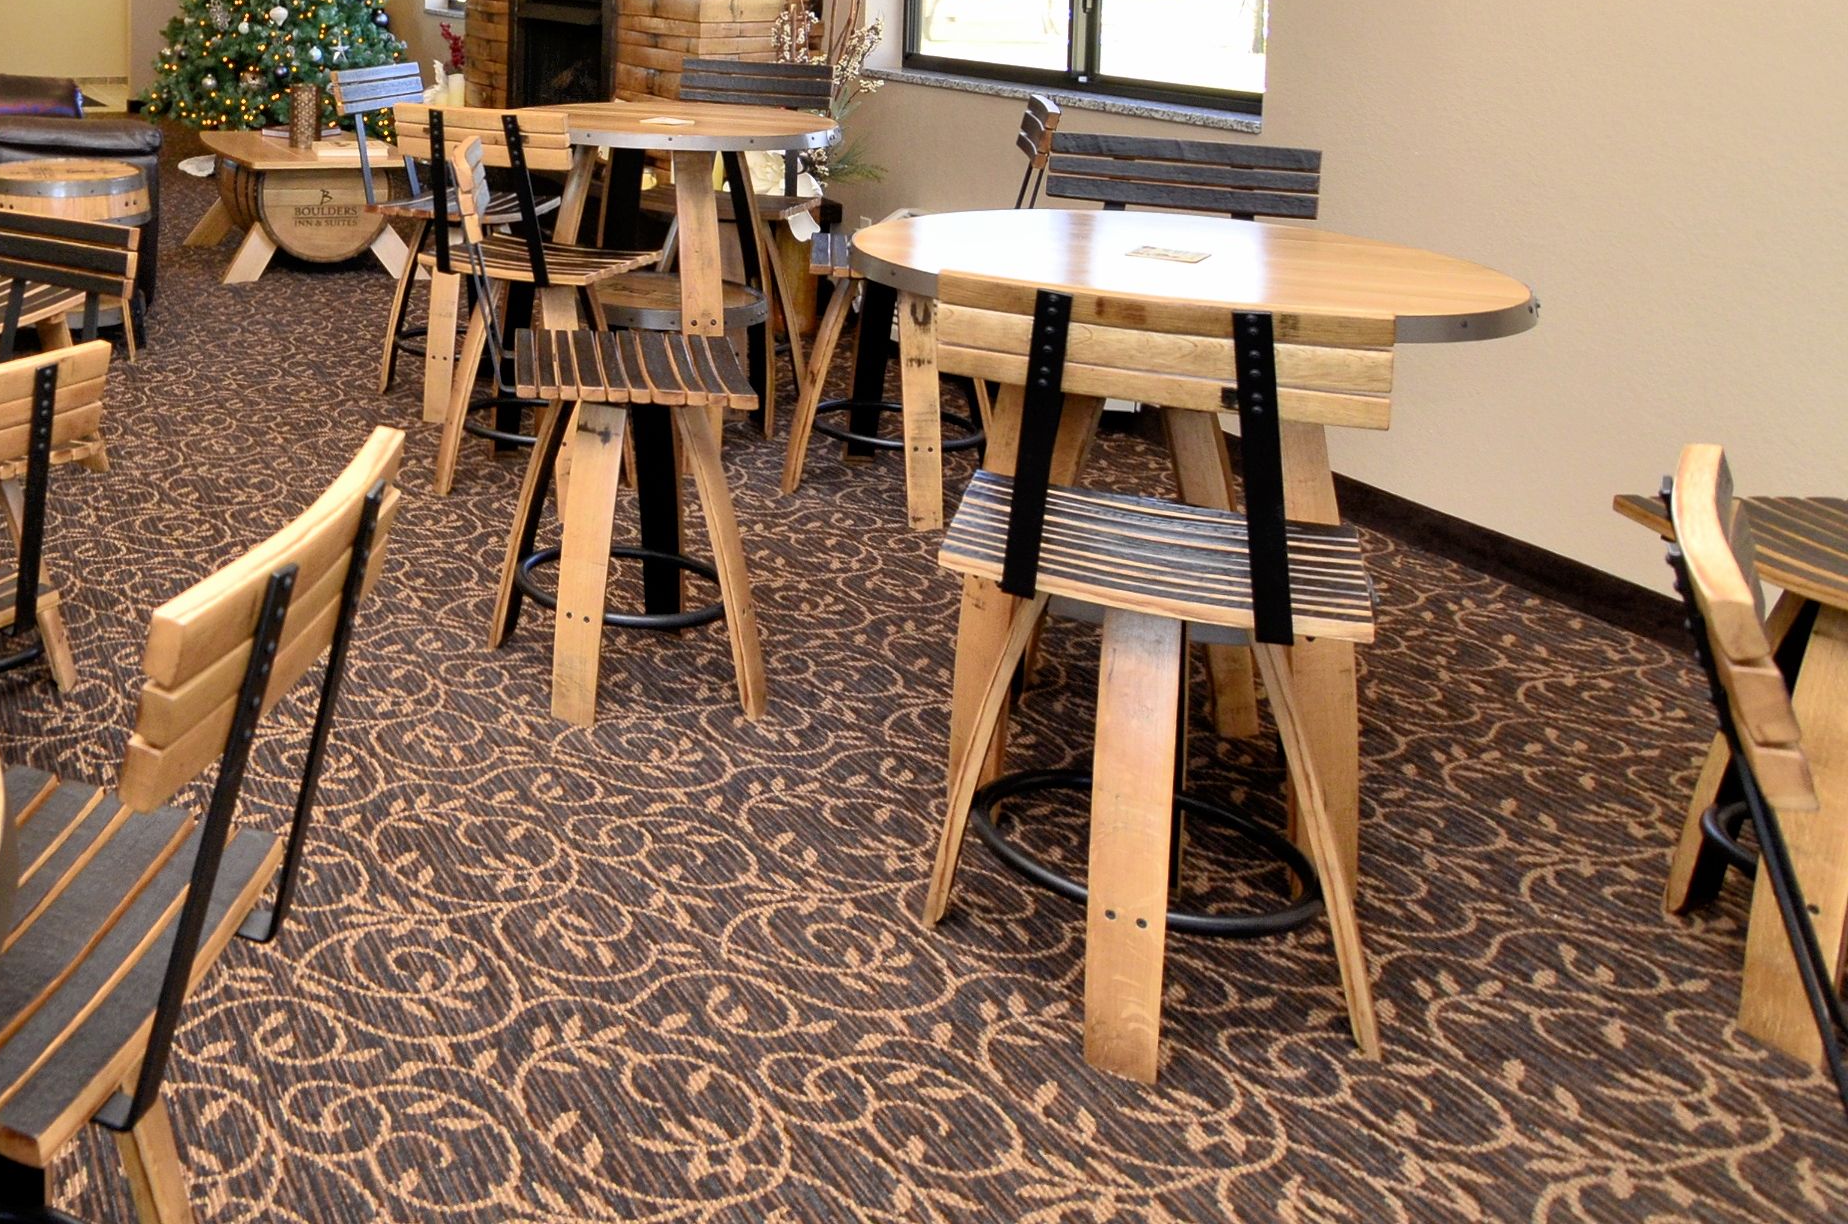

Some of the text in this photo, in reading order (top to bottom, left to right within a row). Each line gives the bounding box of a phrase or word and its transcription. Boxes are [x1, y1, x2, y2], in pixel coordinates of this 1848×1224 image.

[294, 206, 358, 216] BOULDERS
[294, 219, 312, 227] INN
[324, 219, 358, 227] SUITES
